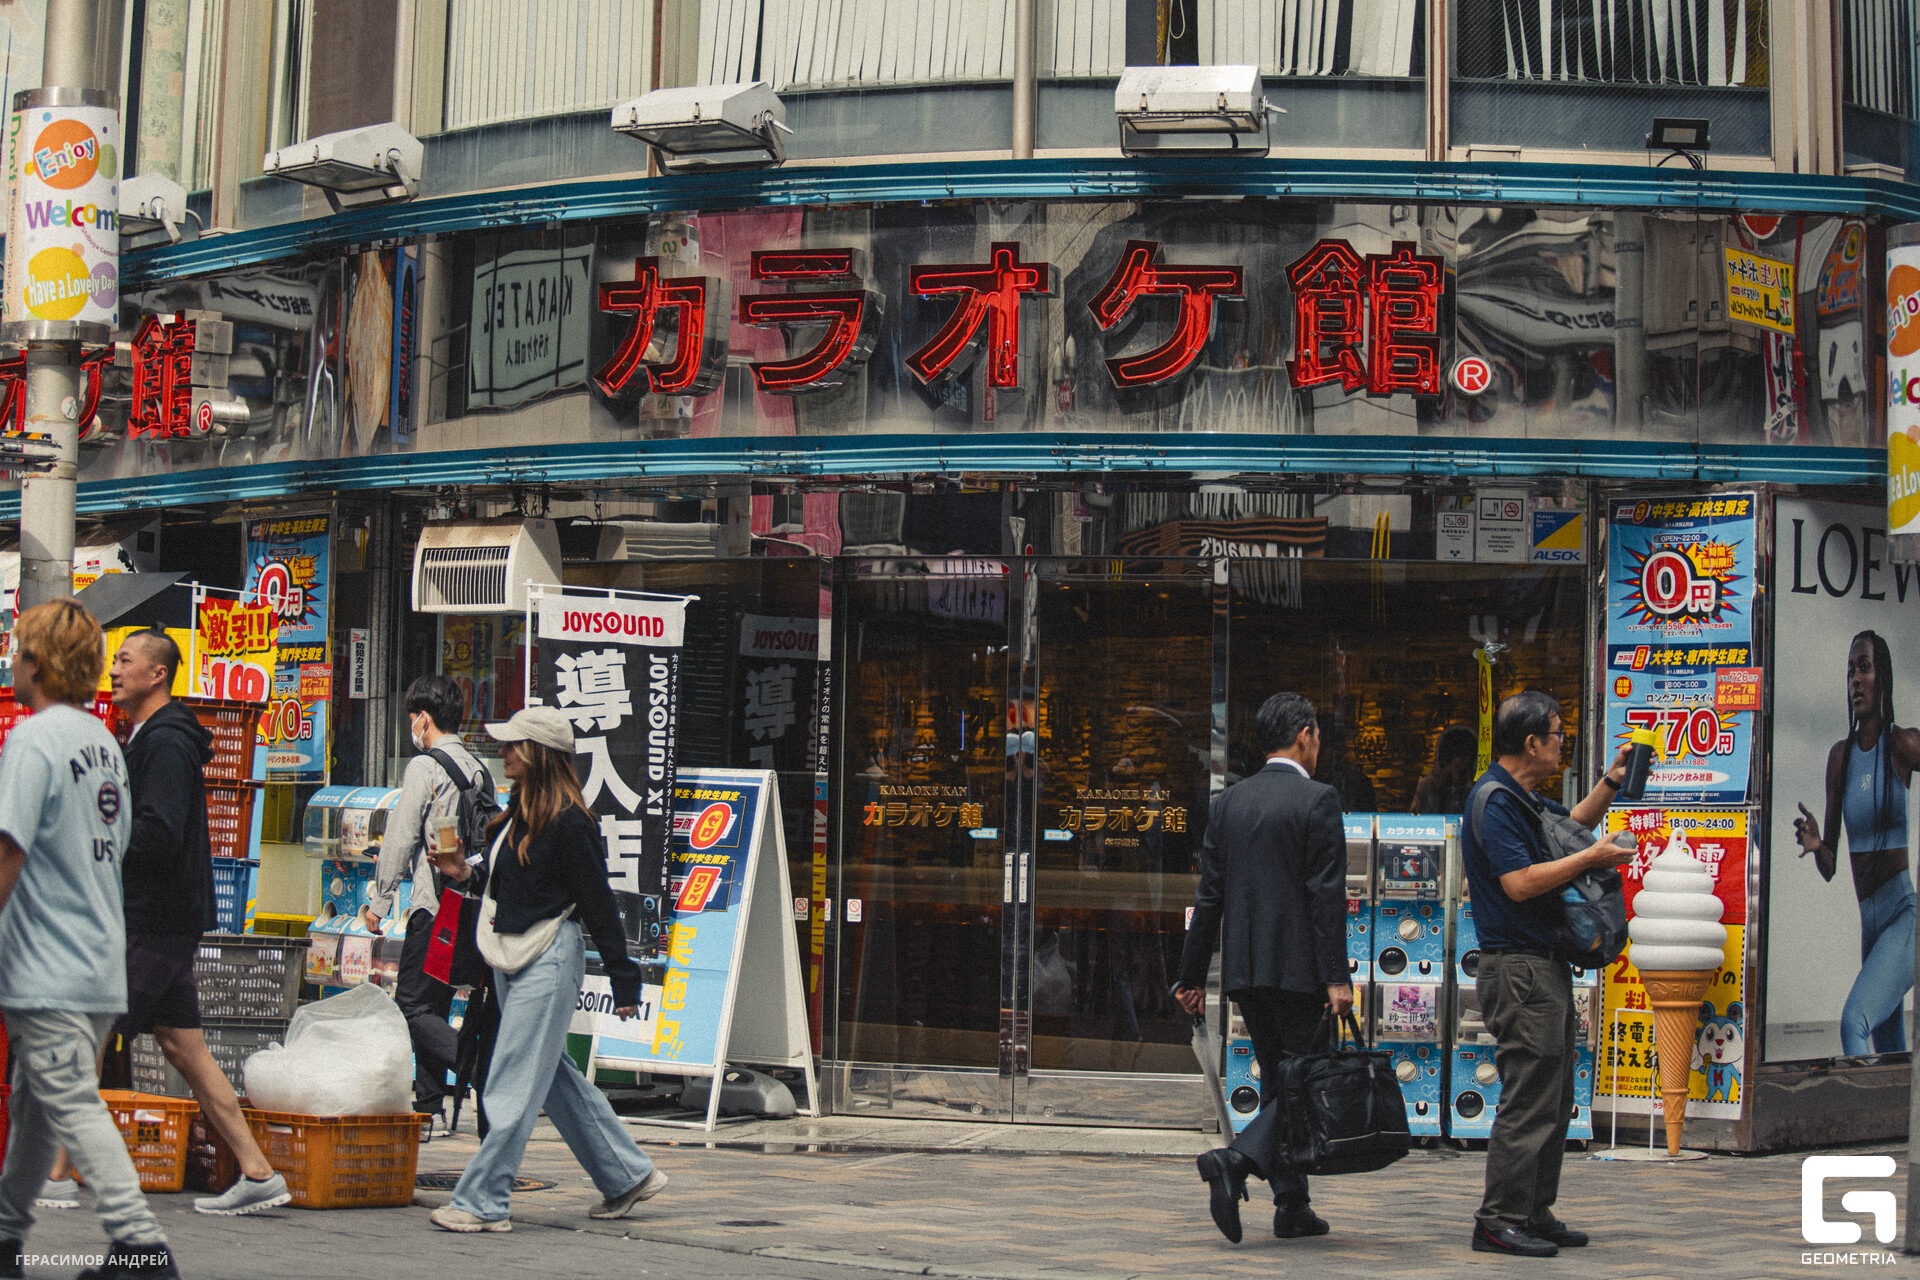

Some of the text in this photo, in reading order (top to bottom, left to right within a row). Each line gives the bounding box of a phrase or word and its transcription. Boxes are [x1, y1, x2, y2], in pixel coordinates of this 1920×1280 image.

[35, 137, 95, 180] Enjoy
[28, 273, 58, 308] Have
[58, 279, 66, 300] a
[66, 272, 100, 298] Lovely
[593, 238, 1446, 398] カラオケ館
[1888, 293, 1920, 343] Enjo
[1888, 368, 1920, 408] elc
[1533, 551, 1581, 561] ALSOK
[1642, 551, 1716, 614] 0円
[562, 611, 664, 638] JOYSOUND
[354, 642, 365, 692] 防犯カメラ設置
[649, 654, 669, 781] JOYSOUND
[70, 744, 128, 786] AVIRE
[1649, 772, 1713, 782] フトドリンク飲み放題
[880, 785, 968, 796] KARAOKE KAN
[1076, 789, 1140, 800] KARAOKE
[864, 802, 984, 828] カラオケ館
[1059, 806, 1188, 833] カラオケ館
[1630, 812, 1664, 831] 特報!!
[1714, 1069, 1724, 1087] K
